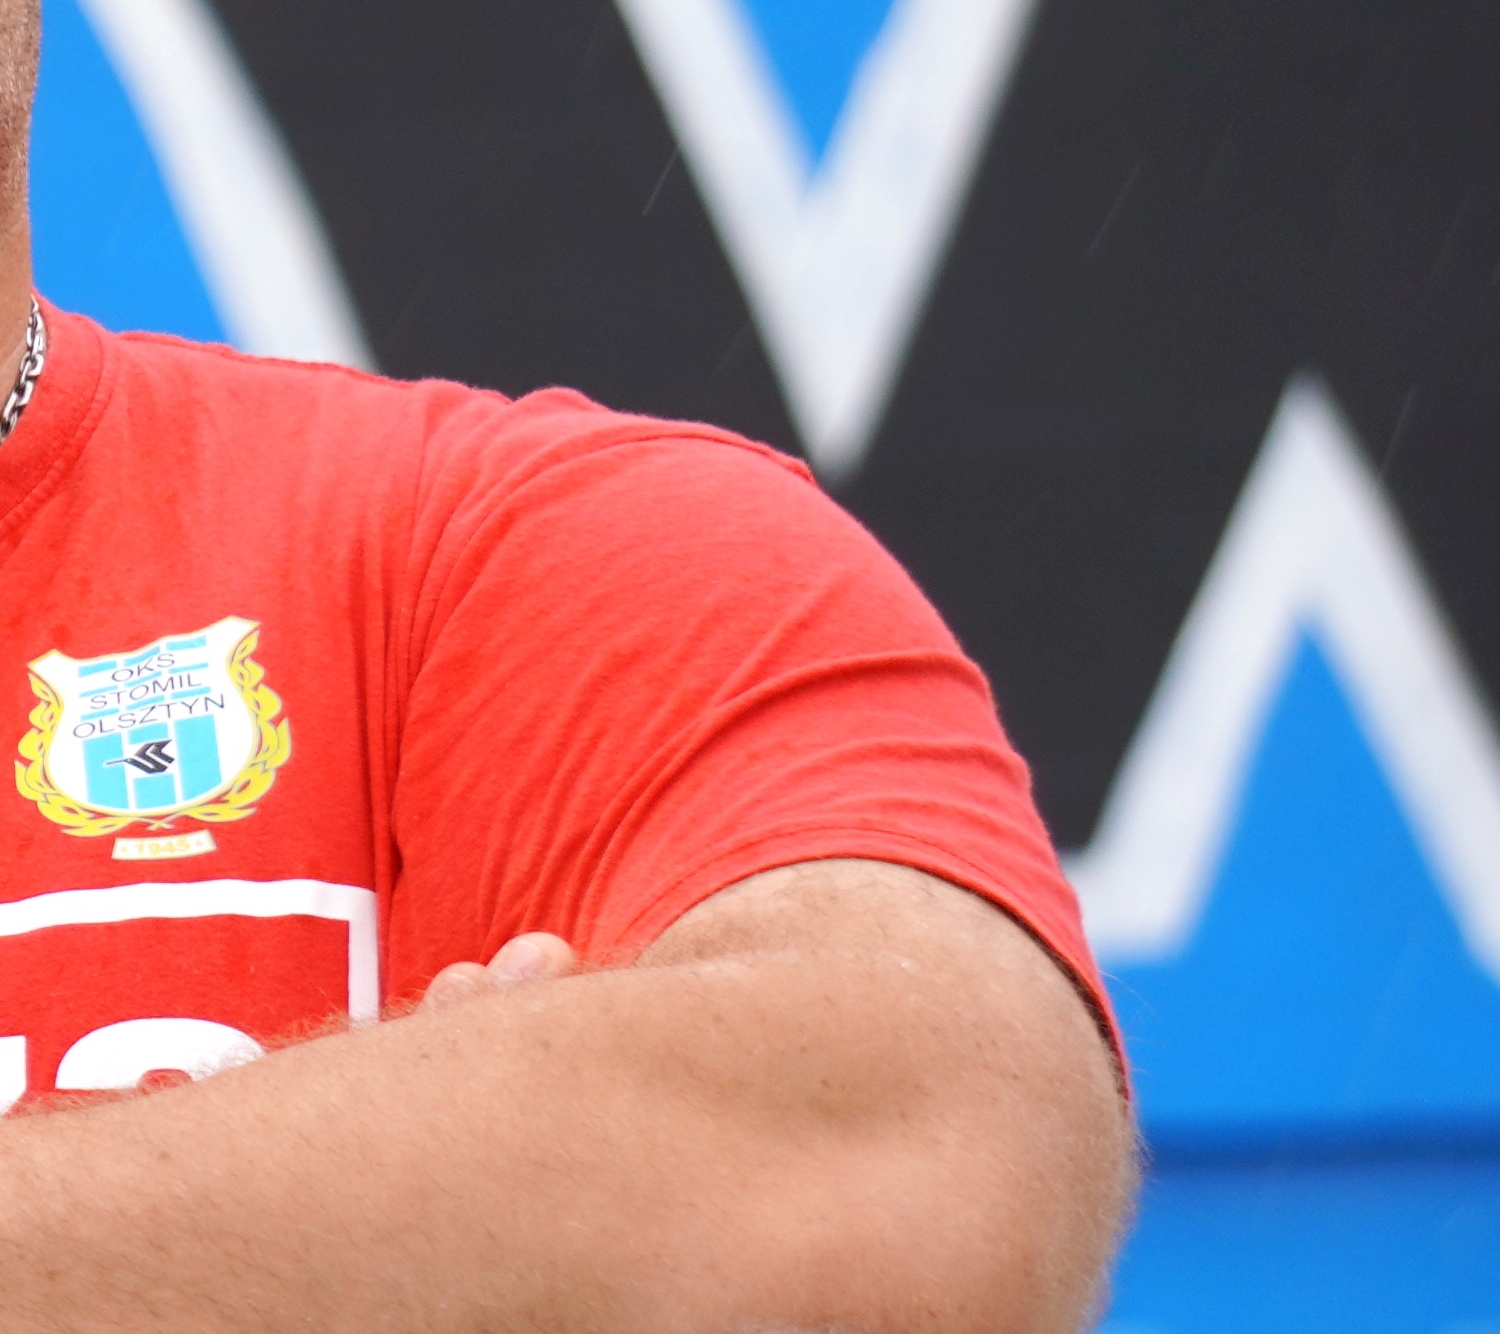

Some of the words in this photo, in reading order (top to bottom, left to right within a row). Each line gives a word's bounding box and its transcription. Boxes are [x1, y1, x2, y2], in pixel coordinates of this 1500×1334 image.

[111, 652, 175, 683] OKS
[90, 672, 202, 710] STOMIL
[72, 693, 226, 740] OLSZTYN
[134, 837, 191, 855] 1945
